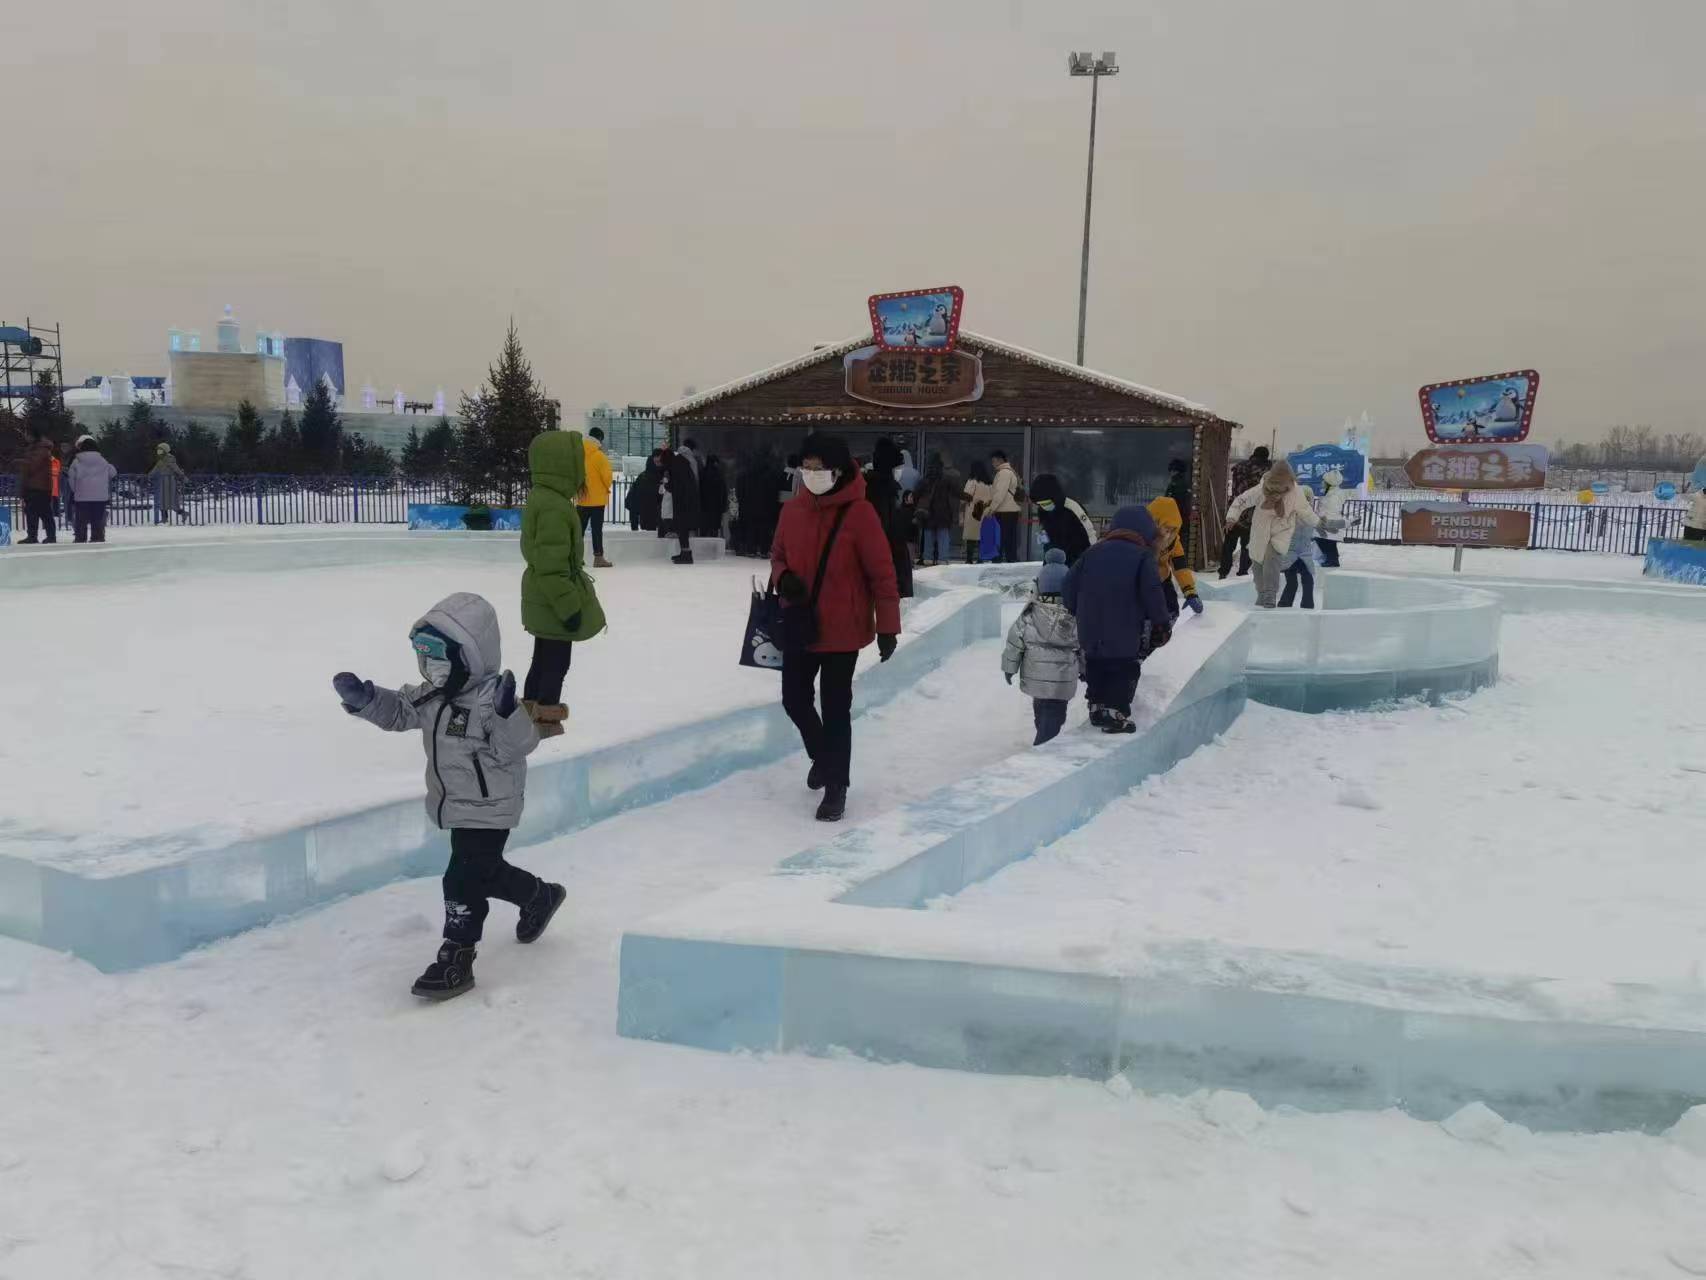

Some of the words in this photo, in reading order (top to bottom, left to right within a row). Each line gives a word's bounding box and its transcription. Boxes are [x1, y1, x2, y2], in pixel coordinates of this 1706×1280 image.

[1422, 453, 1535, 481] 企鹅之家
[1431, 515, 1497, 528] PENGUIN
[1437, 528, 1489, 540] HOUSE
